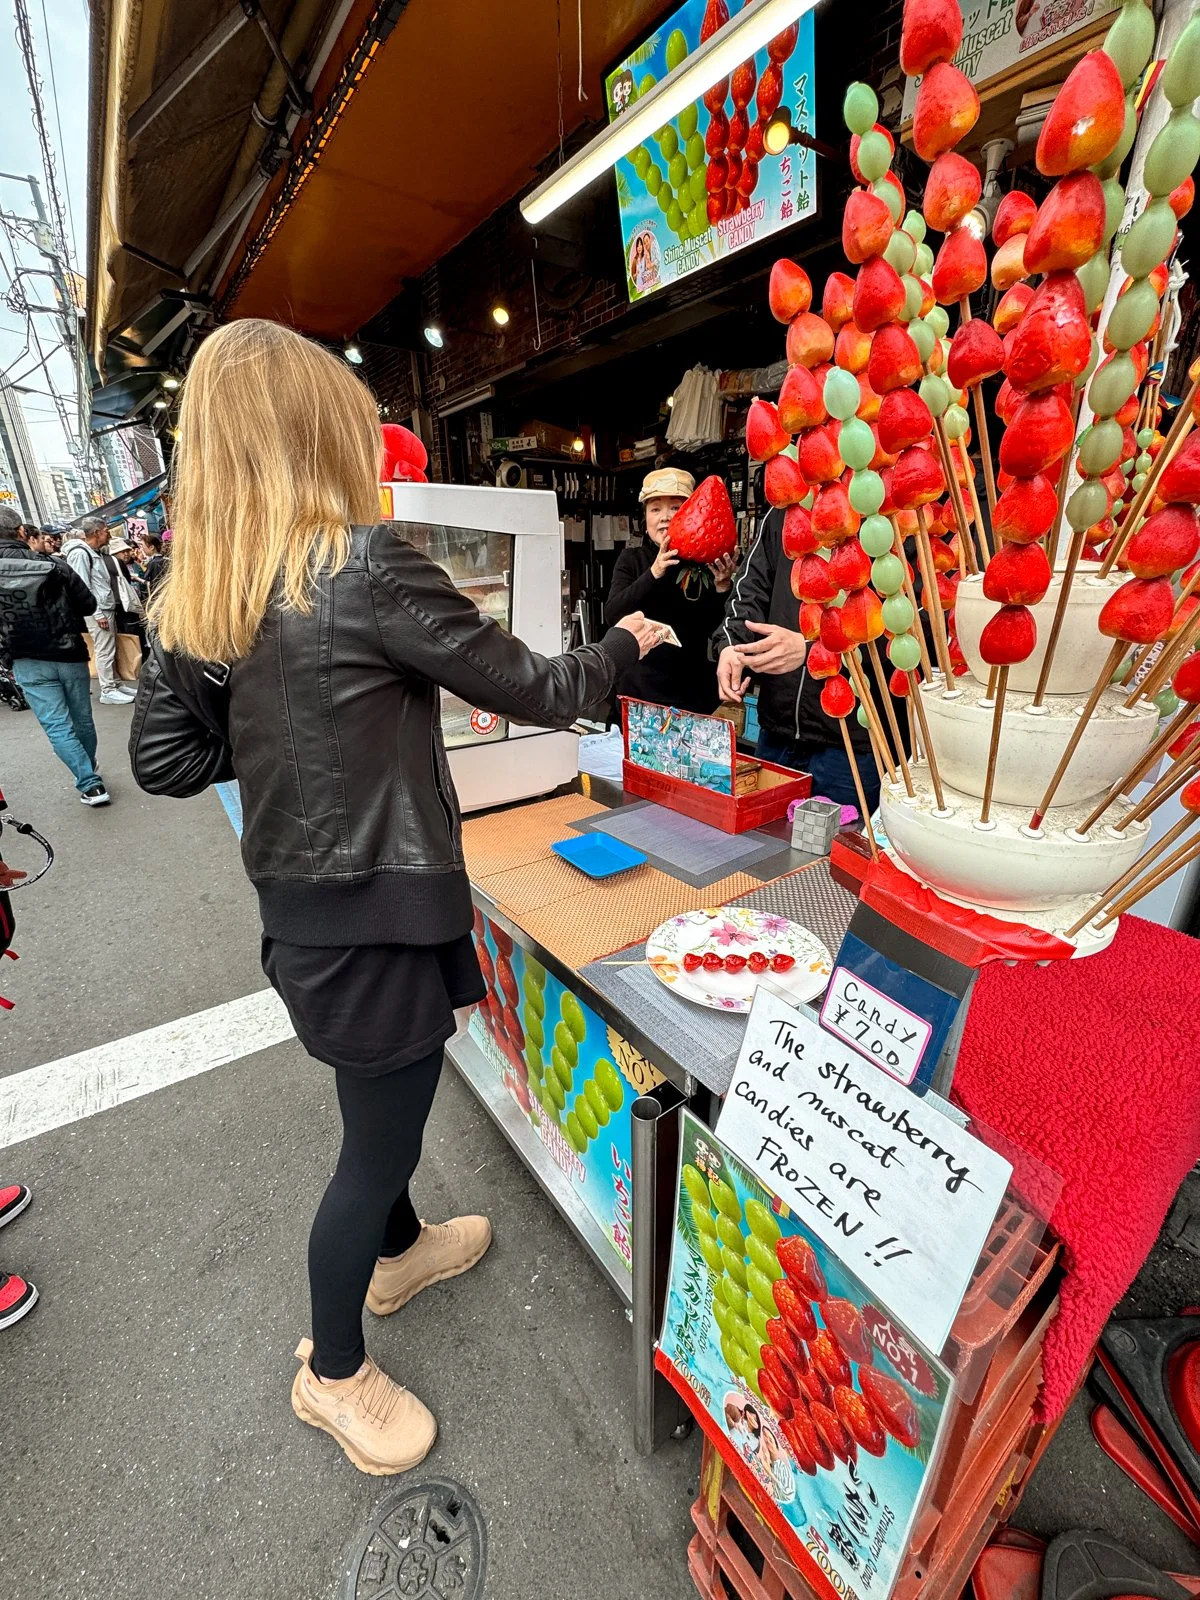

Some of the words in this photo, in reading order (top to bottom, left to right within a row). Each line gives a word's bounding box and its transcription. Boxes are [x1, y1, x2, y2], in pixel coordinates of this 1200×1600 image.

[717, 199, 765, 238] Strawberry
[779, 156, 794, 221] ちご飴
[663, 244, 685, 266] Shine
[684, 227, 712, 254] Muscat
[676, 250, 700, 276] CANDY
[728, 222, 756, 250] CANDY
[833, 1004, 902, 1066] ¥700
[844, 982, 917, 1043] Candy
[528, 1087, 586, 1184] Strawberry
[749, 1050, 785, 1082] and
[799, 1091, 904, 1168] muscat
[769, 1019, 804, 1061] The
[819, 1060, 984, 1195] strawberry
[540, 1124, 573, 1182] CANDY
[735, 1081, 814, 1151] candies
[830, 1163, 881, 1217] are
[611, 1142, 632, 1261] いちご飴
[675, 1243, 707, 1358] マスカット飴
[702, 1268, 719, 1316] Muscat
[697, 1314, 712, 1354] Candy
[873, 1324, 918, 1384] NO.1
[878, 1320, 918, 1366] 人気
[828, 1456, 878, 1571] いちご飴
[873, 1504, 895, 1562] Strawberry
[860, 1557, 878, 1591] Candy
